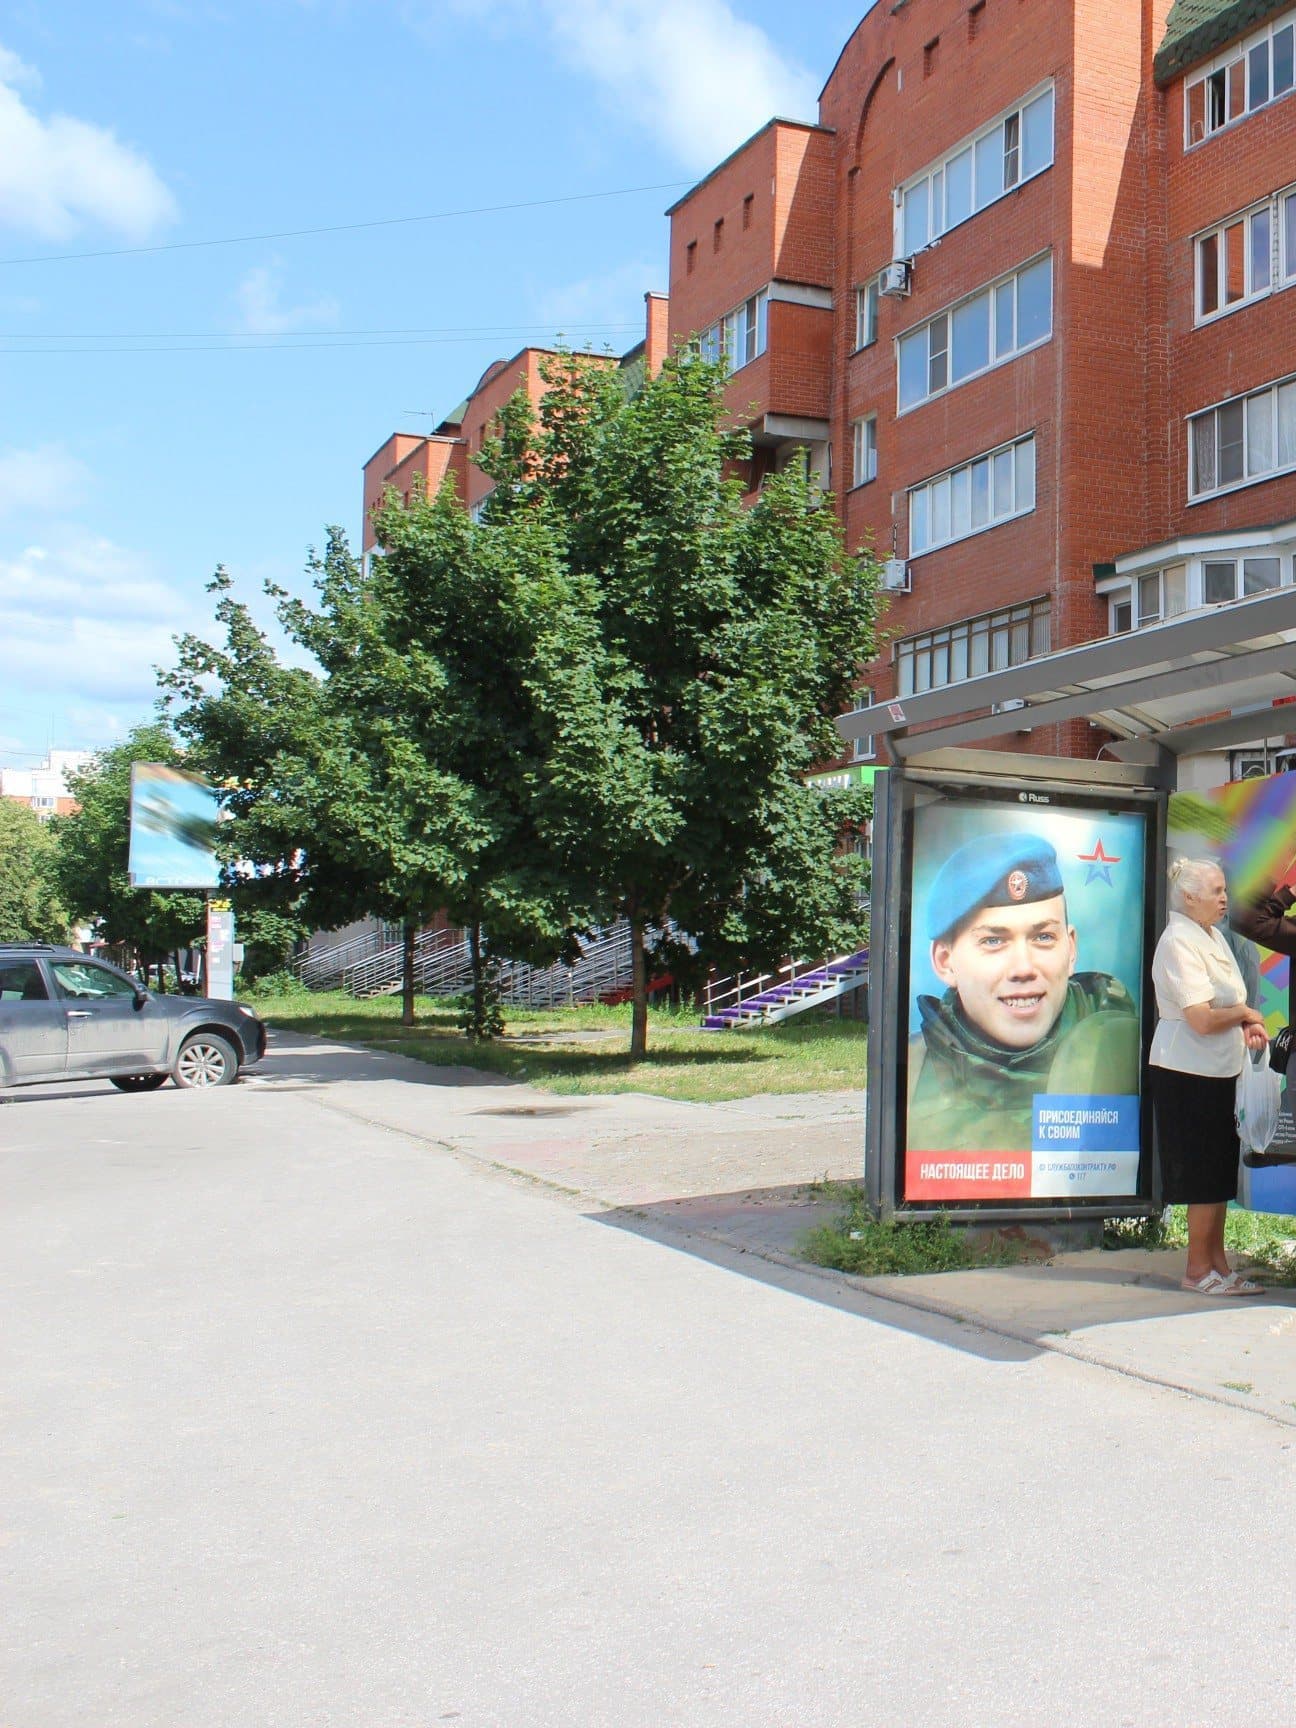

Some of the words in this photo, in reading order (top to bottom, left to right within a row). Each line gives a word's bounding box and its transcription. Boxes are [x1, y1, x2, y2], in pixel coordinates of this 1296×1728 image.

[1039, 1108, 1119, 1125] ПРИСОЕДИНЯЙСЯ
[1039, 1125, 1045, 1138] К
[1047, 1125, 1080, 1138] СВОИМ
[920, 1163, 989, 1180] НАСТОЯЩЕЕ
[992, 1163, 1025, 1180] ДЕЛО
